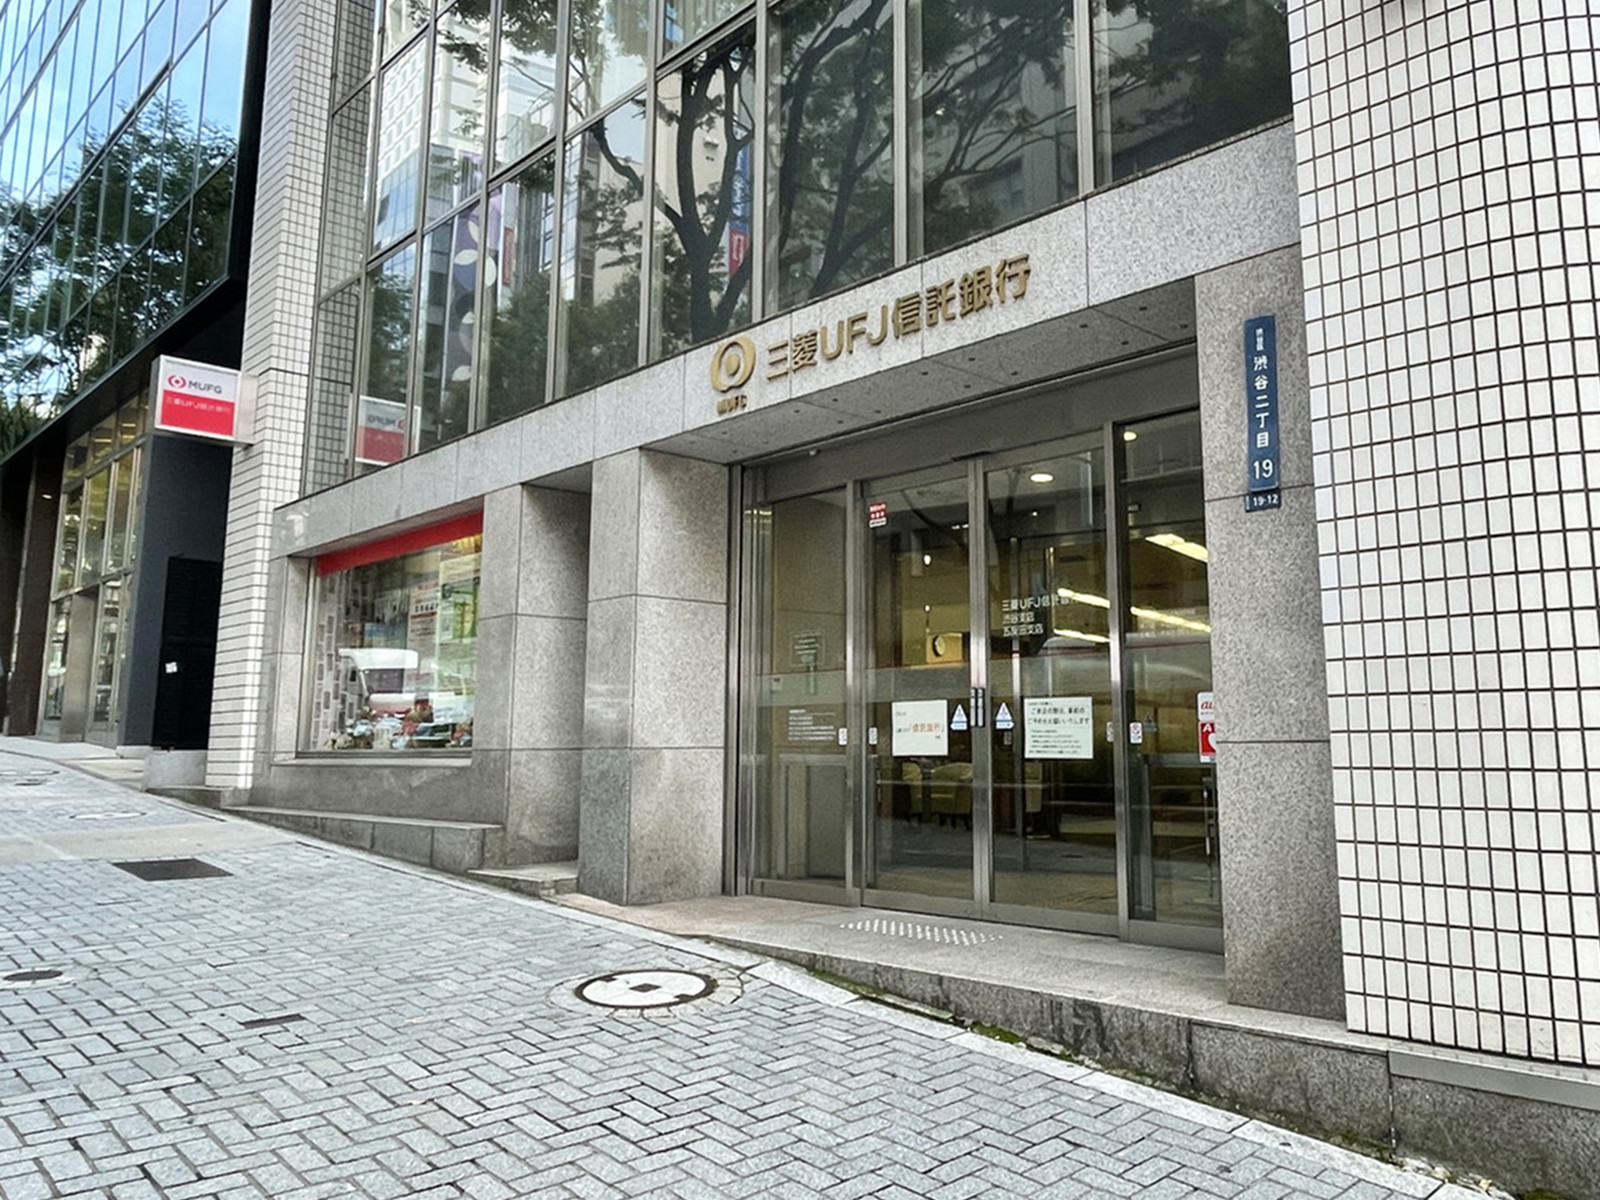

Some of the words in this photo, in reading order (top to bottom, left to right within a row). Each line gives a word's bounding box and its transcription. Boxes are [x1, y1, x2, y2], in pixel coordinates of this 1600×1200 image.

[766, 253, 1031, 381] 三菱UFJ信託銀行
[188, 380, 222, 394] MUFG
[1253, 354, 1271, 448] 渋谷二丁目
[1253, 458, 1273, 479] 19
[1253, 494, 1279, 506] 19-12
